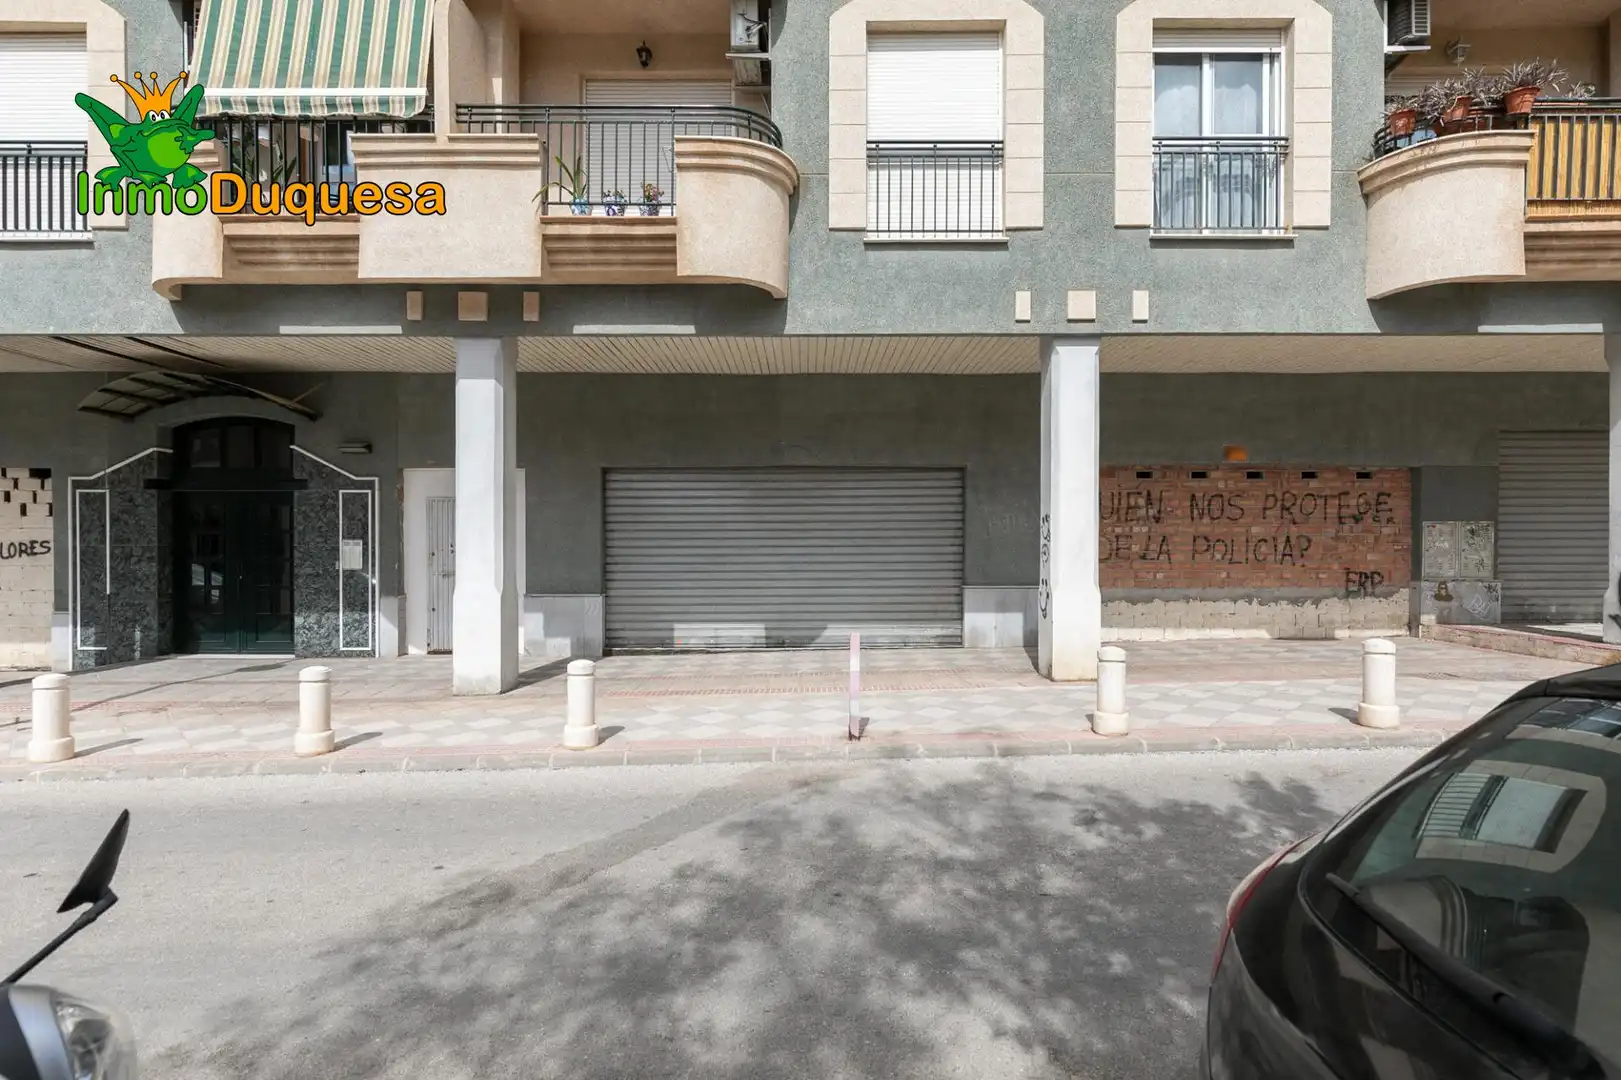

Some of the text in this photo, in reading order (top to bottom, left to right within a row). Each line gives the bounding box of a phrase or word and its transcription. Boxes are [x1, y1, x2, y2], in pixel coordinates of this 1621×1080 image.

[1189, 493, 1245, 522] NOS
[1262, 490, 1393, 525] PROTEGE
[0, 540, 51, 560] LORES
[1139, 535, 1172, 564] LA
